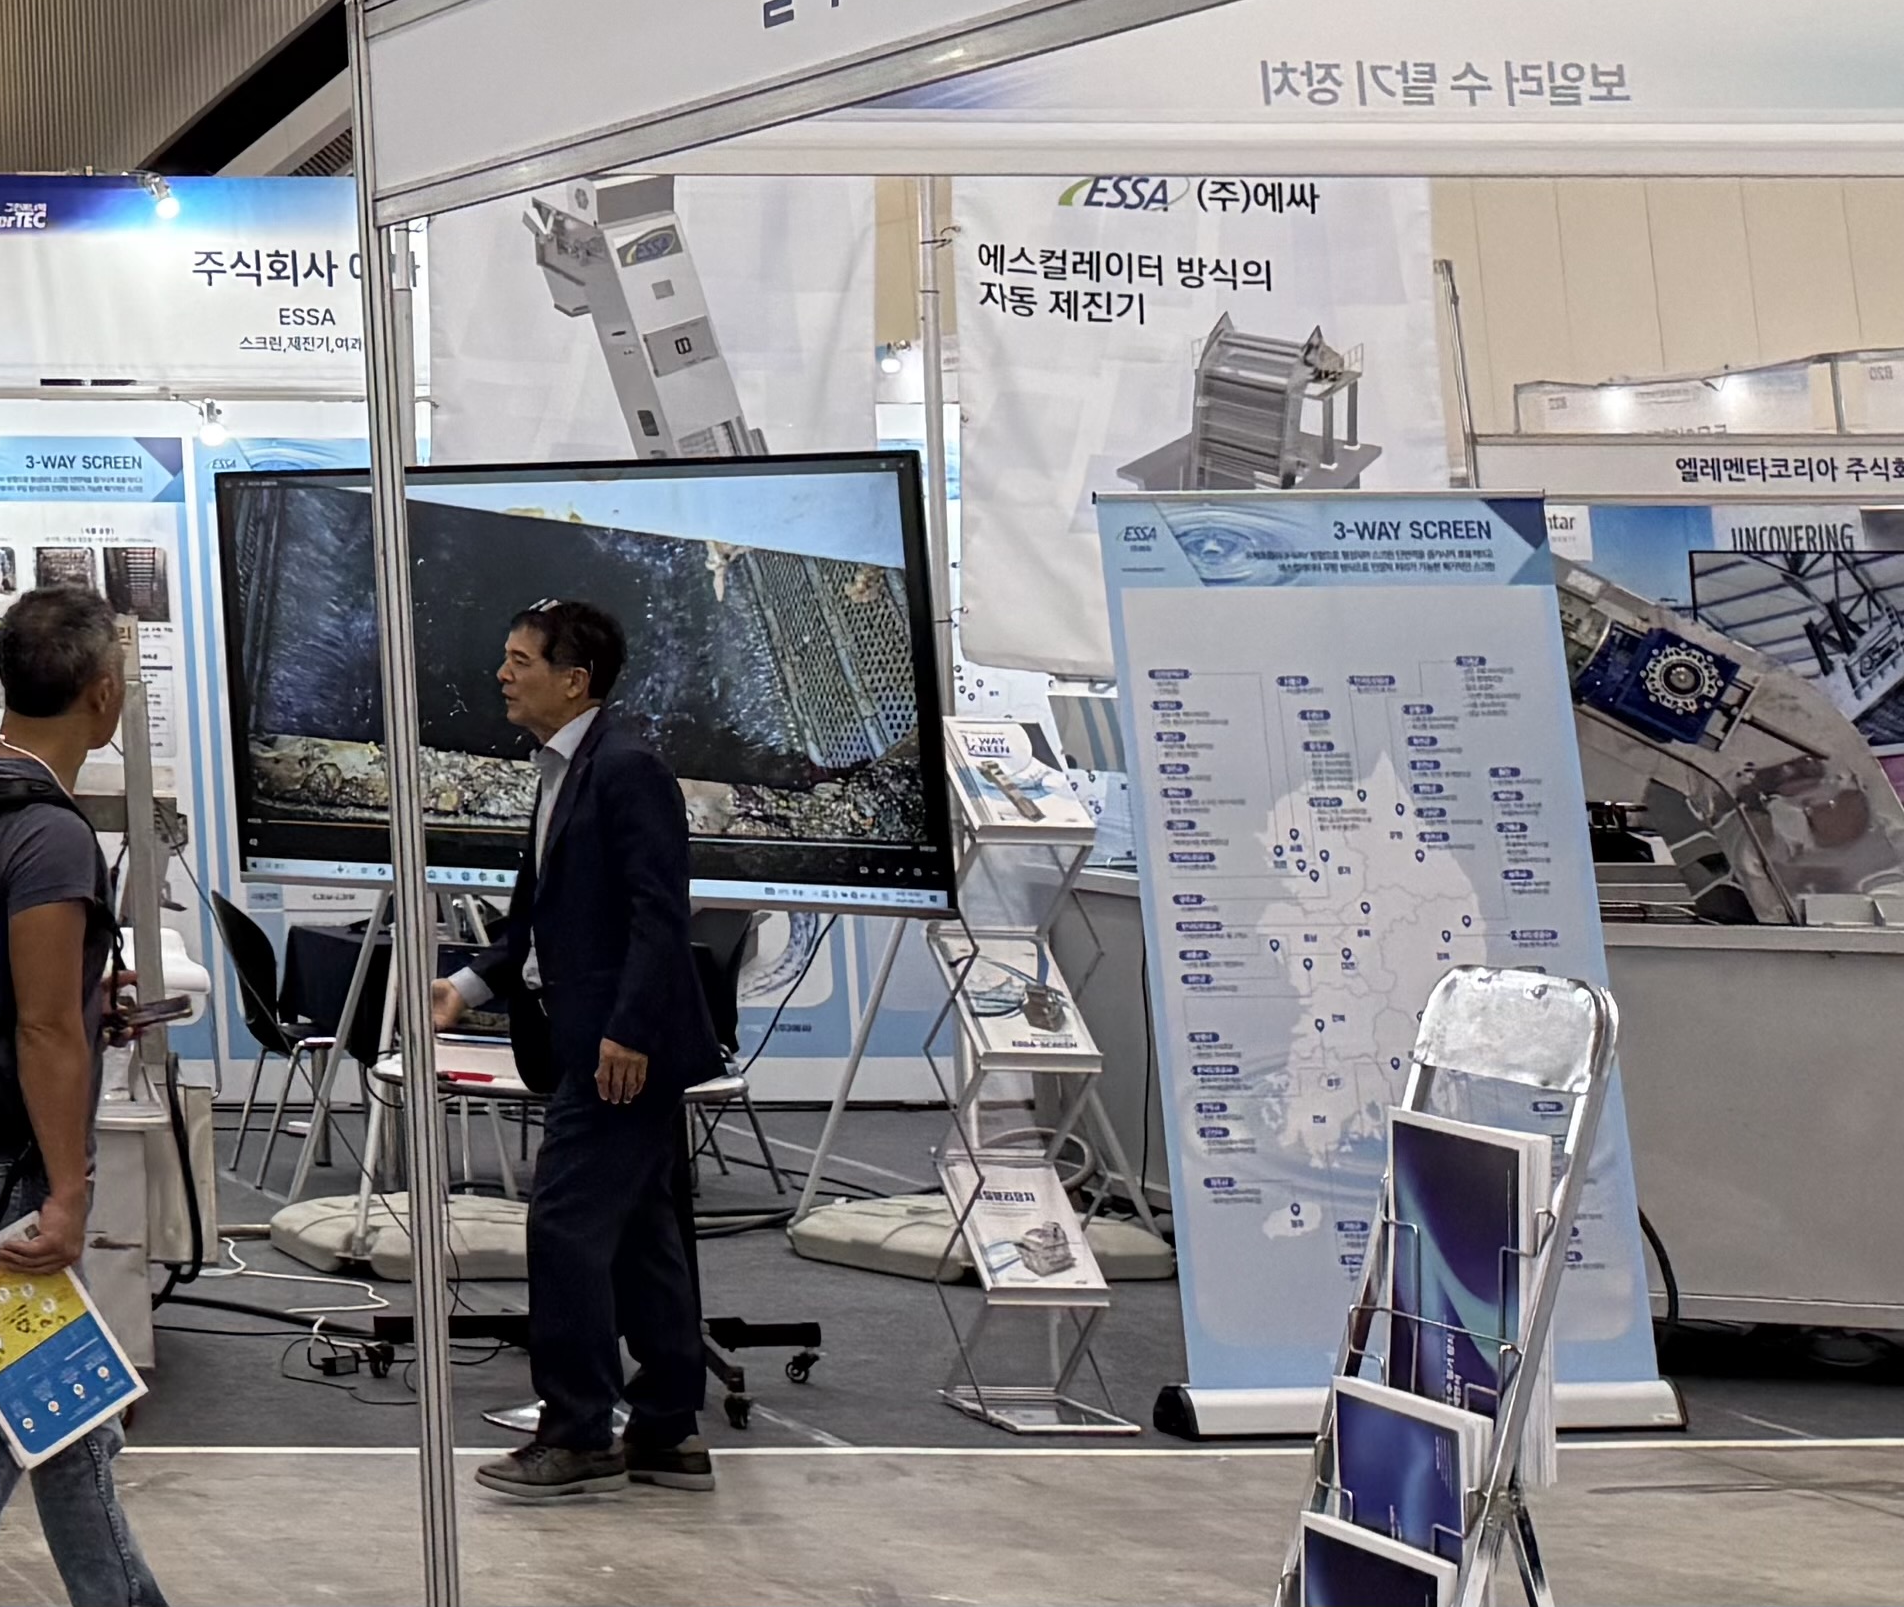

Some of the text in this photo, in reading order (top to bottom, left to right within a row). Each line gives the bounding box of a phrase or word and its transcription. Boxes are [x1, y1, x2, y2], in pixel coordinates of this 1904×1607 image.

[1084, 177, 1320, 215] ESSA (주)에싸
[192, 250, 338, 287] 주식회사
[977, 242, 1273, 292] 에스컬레이터 방식의
[279, 308, 336, 326] ESSA
[977, 283, 1147, 326] 자동 제진기
[26, 456, 142, 470] 3-WAY SCREEN
[1676, 458, 1838, 483] 엘레멘타코리아
[1124, 525, 1158, 541] ESSA
[1334, 520, 1492, 540] 3-WAY SCREEN
[1731, 524, 1854, 552] UNCOVERING
